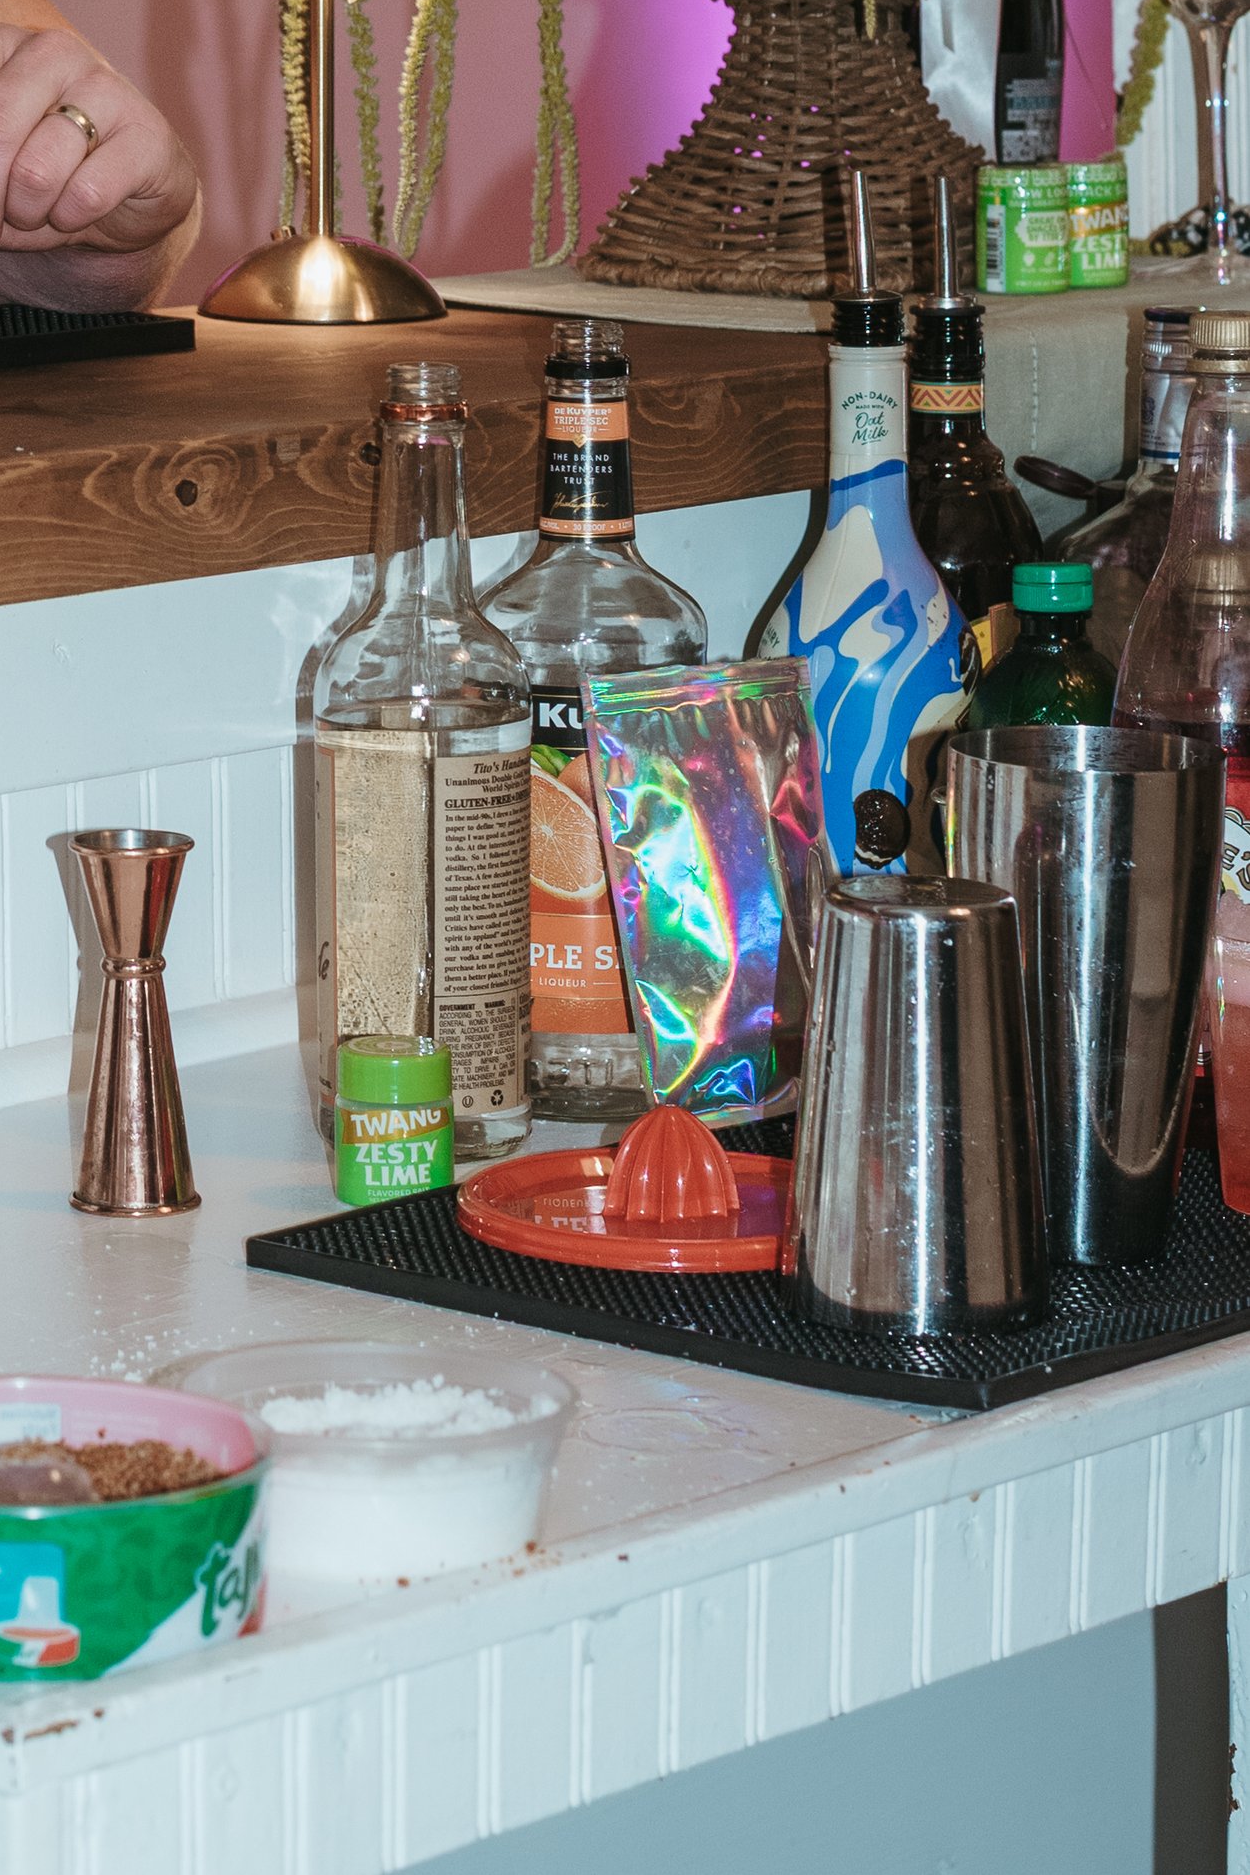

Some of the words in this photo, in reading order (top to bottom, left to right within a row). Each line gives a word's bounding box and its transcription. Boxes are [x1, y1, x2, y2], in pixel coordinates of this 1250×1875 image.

[841, 391, 898, 410] NON-DAIRY
[554, 416, 586, 425] TRIPLE
[589, 417, 610, 425] SEC
[855, 411, 885, 429] Oat
[852, 426, 889, 444] Milk
[553, 453, 568, 461] THE
[573, 453, 610, 462] BRAND
[550, 464, 613, 473] BARTENDERS
[564, 476, 596, 485] TRUST
[473, 762, 500, 774] Tito's
[445, 777, 490, 786] Unanimous
[492, 774, 512, 783] Double
[482, 784, 503, 793] World
[486, 832, 499, 841] good
[445, 854, 468, 862] vodka.
[489, 850, 510, 858] followed
[459, 894, 480, 902] taking
[445, 905, 459, 913] only
[476, 912, 497, 920] smooth
[445, 935, 462, 943] spirit
[597, 945, 620, 970] S
[445, 965, 474, 973] purchase
[497, 961, 507, 969] give
[445, 974, 461, 982] them
[539, 977, 587, 988] LIQUEUR
[453, 985, 468, 993] your
[469, 983, 489, 991] closest
[468, 1018, 488, 1026] WOMEN
[490, 1015, 507, 1024] SHOULD
[461, 1026, 489, 1034] ALCOHOLIC
[465, 1033, 495, 1042] PREGNANCY
[461, 1043, 473, 1051] RISK
[487, 1048, 493, 1056] OF
[474, 1064, 489, 1073] DRIVE
[499, 1061, 508, 1069] CAR
[498, 1070, 507, 1078] AND
[459, 1082, 479, 1091] HEALTH
[350, 1110, 441, 1137] TWANG
[355, 1140, 437, 1164] ZESTY
[364, 1163, 432, 1185] LIME
